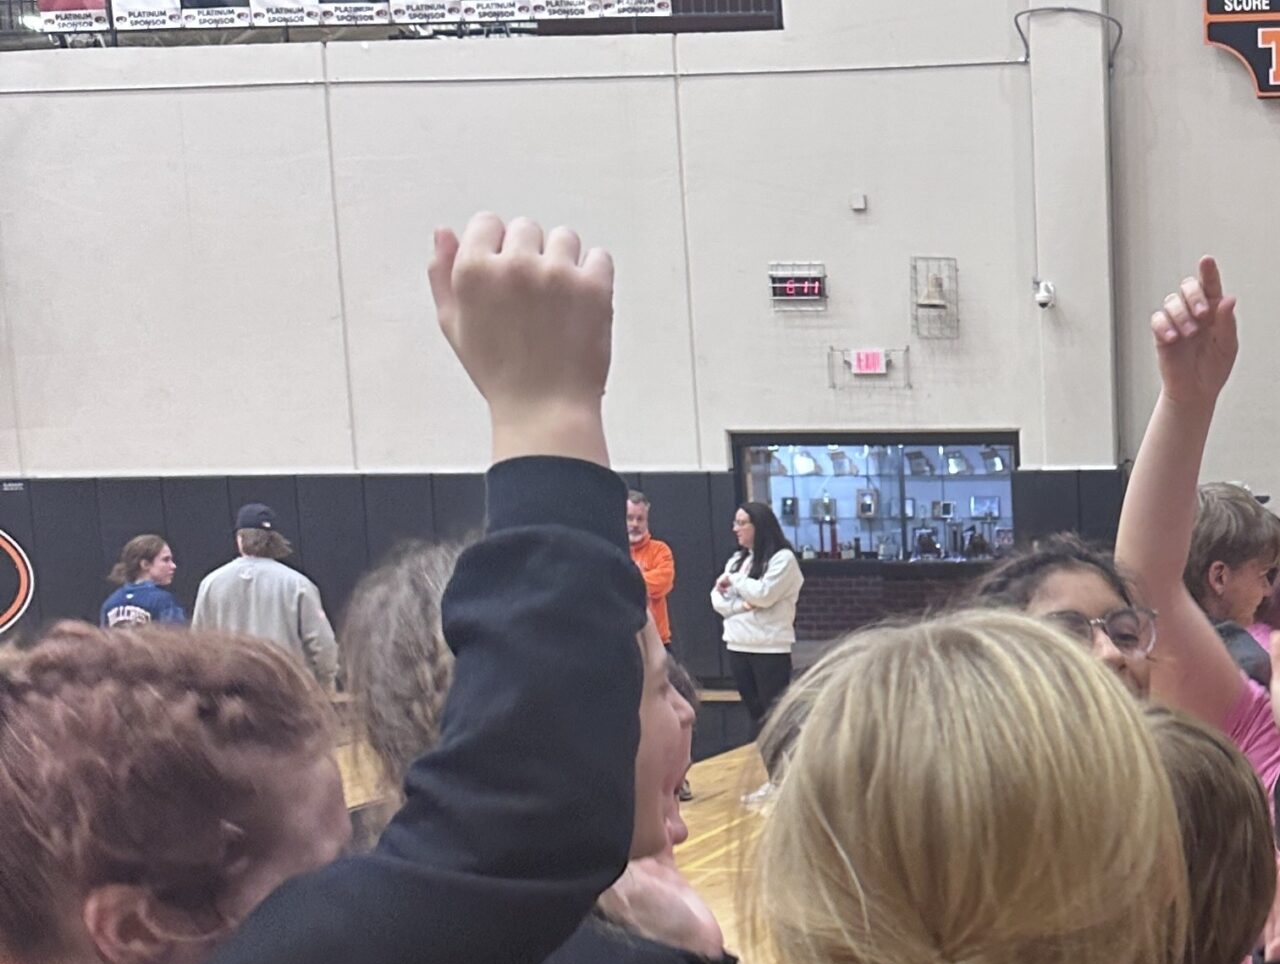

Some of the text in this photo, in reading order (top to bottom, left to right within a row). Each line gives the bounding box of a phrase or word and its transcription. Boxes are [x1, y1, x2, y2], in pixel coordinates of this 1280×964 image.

[617, 6, 655, 14] SPONSOR
[1224, 0, 1270, 12] SCORE
[408, 11, 446, 20] SPONSOR
[478, 10, 515, 18] SPONSOR
[548, 7, 585, 16] SPONSOR
[199, 17, 235, 25] SPONSOR
[268, 14, 304, 23] SPONSOR
[336, 13, 375, 22] SPONSOR
[57, 20, 93, 29] SPONSOR
[130, 18, 166, 27] SPONSOR
